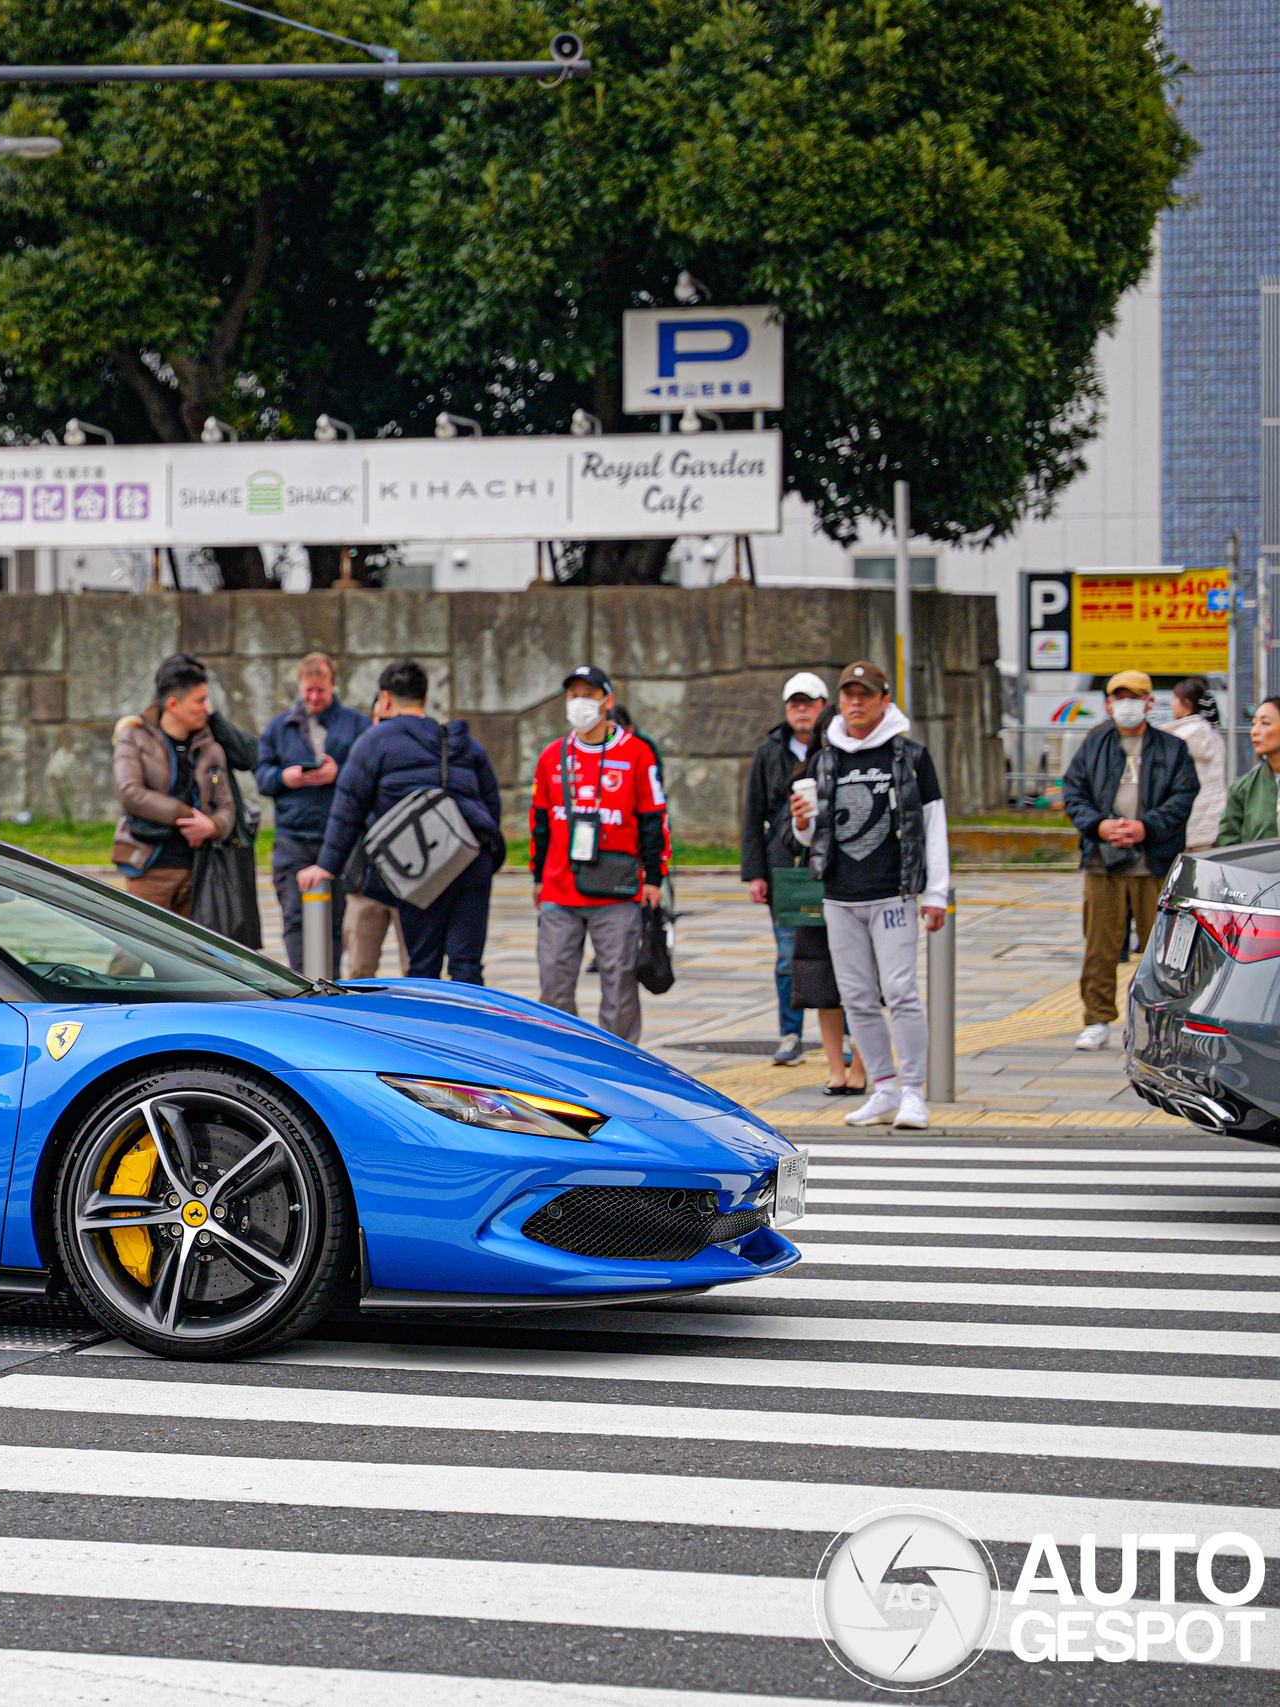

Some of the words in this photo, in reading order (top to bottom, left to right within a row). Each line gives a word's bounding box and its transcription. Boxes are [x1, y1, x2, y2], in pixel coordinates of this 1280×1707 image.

[657, 320, 750, 378] P
[379, 479, 555, 500] KIHACHI
[581, 451, 663, 489] Royal
[670, 448, 766, 478] Garden
[178, 486, 242, 509] SHAKE
[285, 483, 354, 508] SHACK
[642, 484, 705, 520] Cafe
[1030, 580, 1069, 630] P
[252, 1094, 302, 1141] MICHELIN
[82, 1287, 133, 1335] MICHELIN
